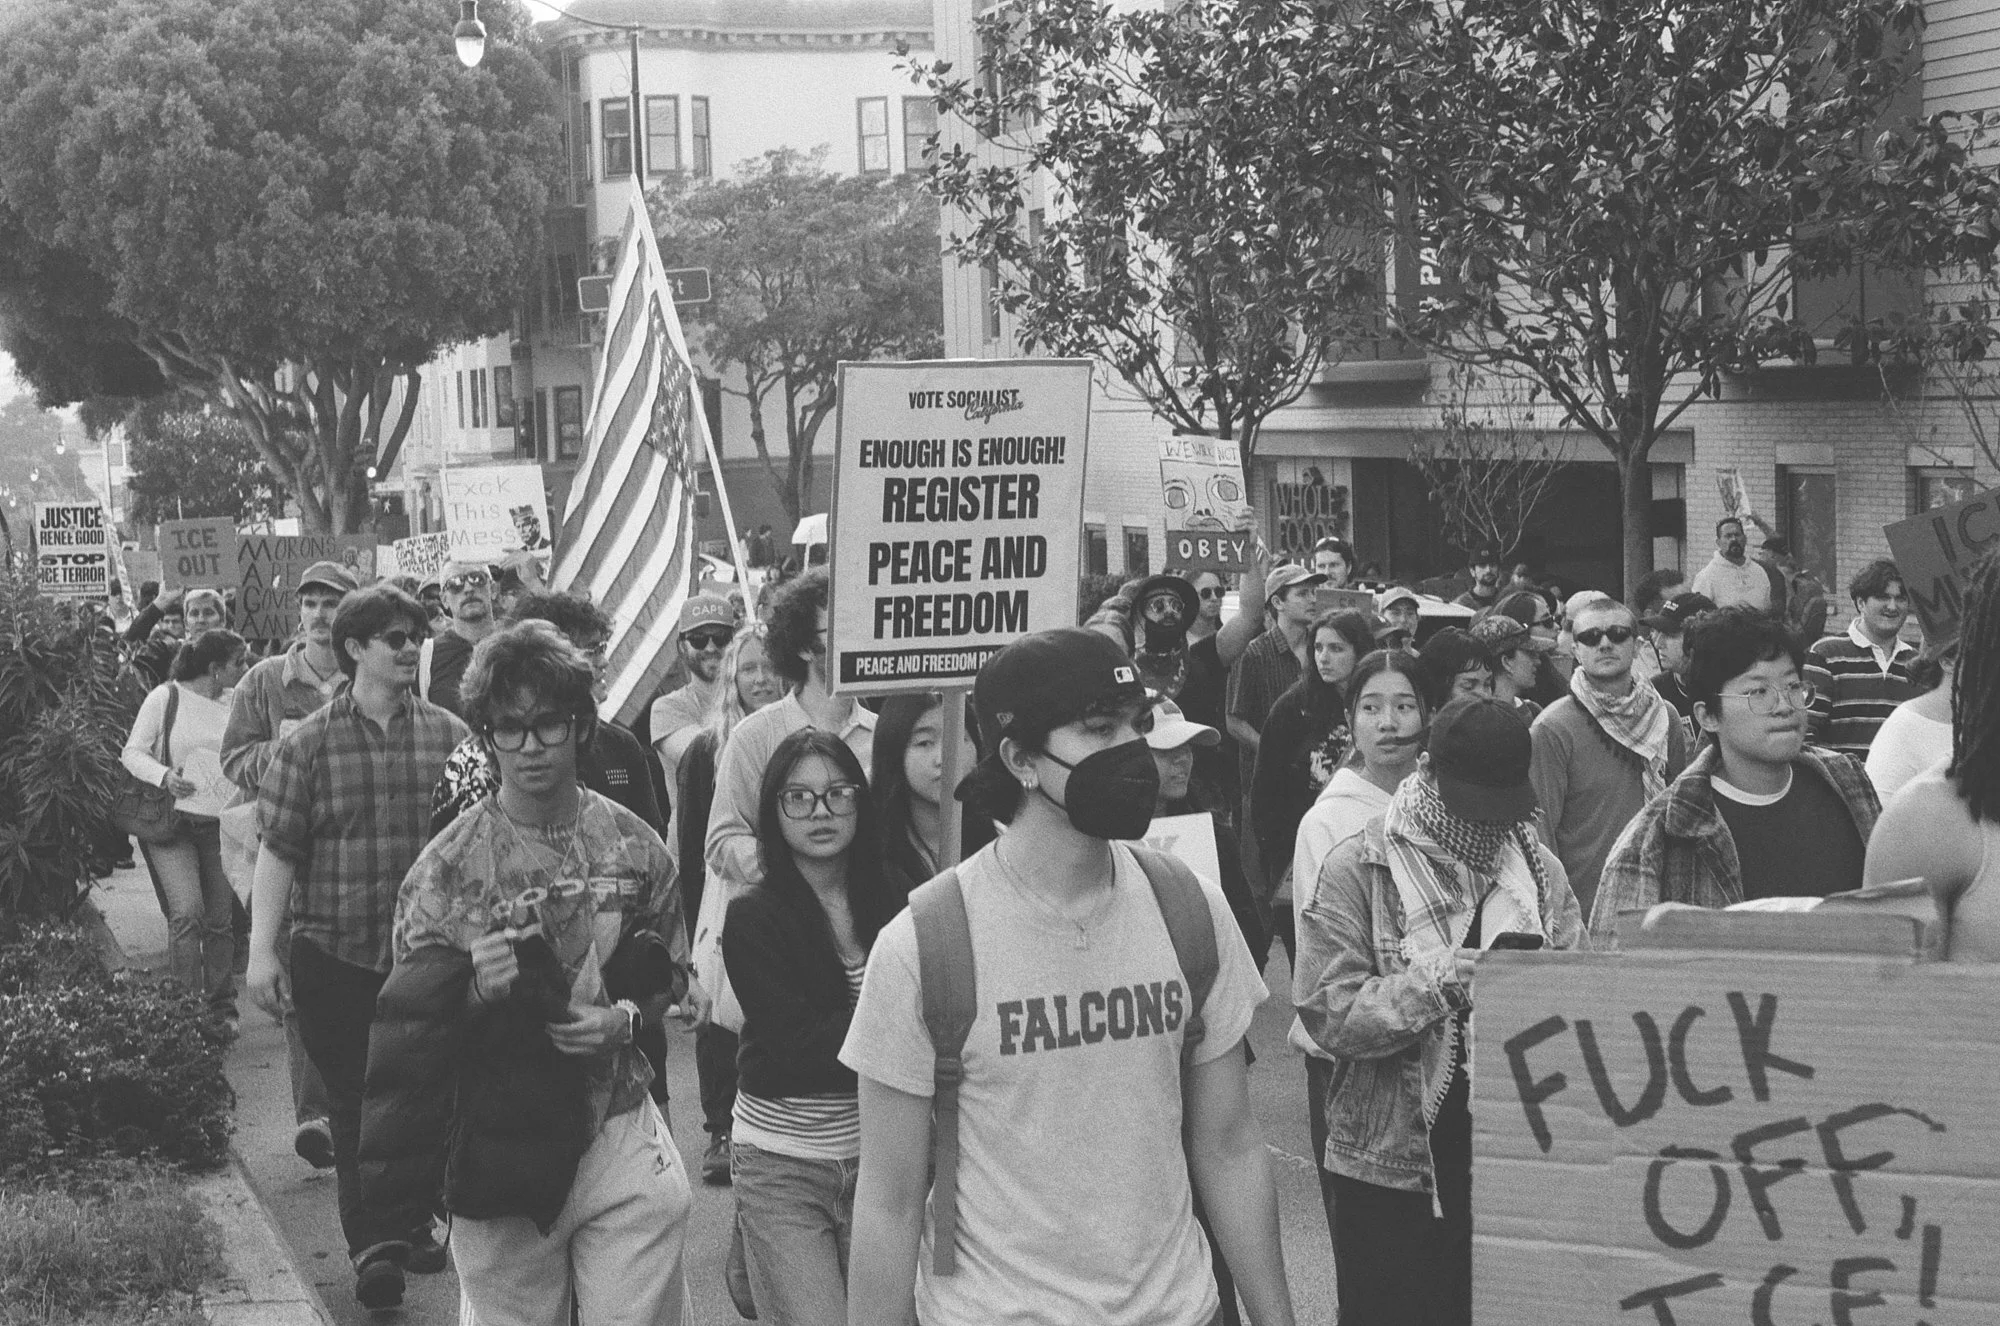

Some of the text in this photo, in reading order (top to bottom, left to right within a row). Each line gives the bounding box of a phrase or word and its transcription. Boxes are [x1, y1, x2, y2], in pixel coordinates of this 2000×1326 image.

[908, 389, 1020, 410] VOTE SOCIALIST
[859, 435, 1066, 468] ENOUGH IS ENOUGH!
[1165, 441, 1191, 459] WE
[1216, 446, 1237, 461] NOT
[882, 473, 1041, 523] REGISTER
[1273, 482, 1338, 520] WHOLE
[40, 506, 103, 529] JUSTICE
[75, 529, 105, 545] GOOD
[171, 527, 218, 550] ICE
[40, 553, 106, 566] STOP
[237, 536, 336, 565] MORONS
[868, 534, 1048, 586] PEACE AND
[1178, 538, 1245, 563] OBEY
[61, 566, 105, 583] TERROR
[177, 553, 221, 577] OUT
[873, 589, 1030, 640] FREEDOM
[855, 656, 896, 677] PEACE
[896, 654, 921, 674] AND
[922, 651, 978, 673] FREEDOM
[996, 980, 1183, 1056] FALCONS
[1503, 991, 1815, 1153] FUCK
[1643, 1102, 1947, 1250] OFF,
